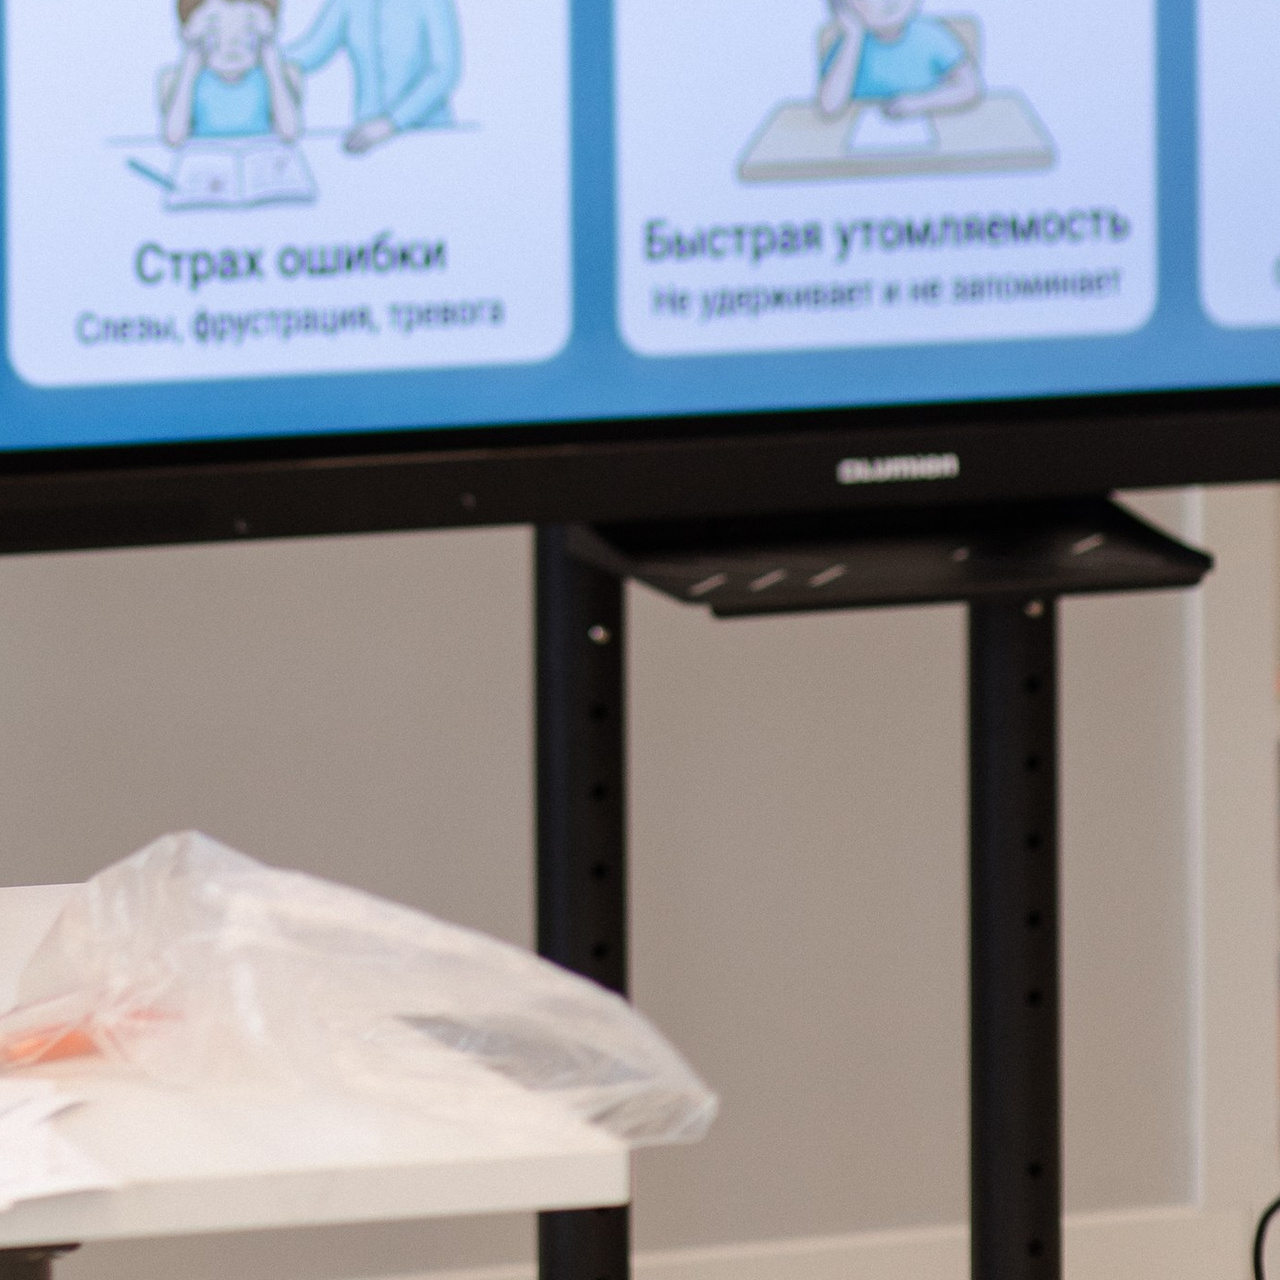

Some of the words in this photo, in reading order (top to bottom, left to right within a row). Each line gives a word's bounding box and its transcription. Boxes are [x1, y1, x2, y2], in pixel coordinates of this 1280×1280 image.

[134, 242, 264, 292] Страх
[276, 232, 446, 279] ошибки
[644, 219, 823, 264] Быстрая
[835, 209, 1131, 261] утомляемость
[652, 289, 692, 315] Не
[701, 281, 873, 319] удерживает
[882, 283, 901, 305] и
[908, 279, 943, 303] не
[951, 269, 1121, 303] запоминает
[75, 312, 182, 346] Слезы,
[191, 305, 378, 344] фрустрация,
[389, 300, 505, 333] тревога
